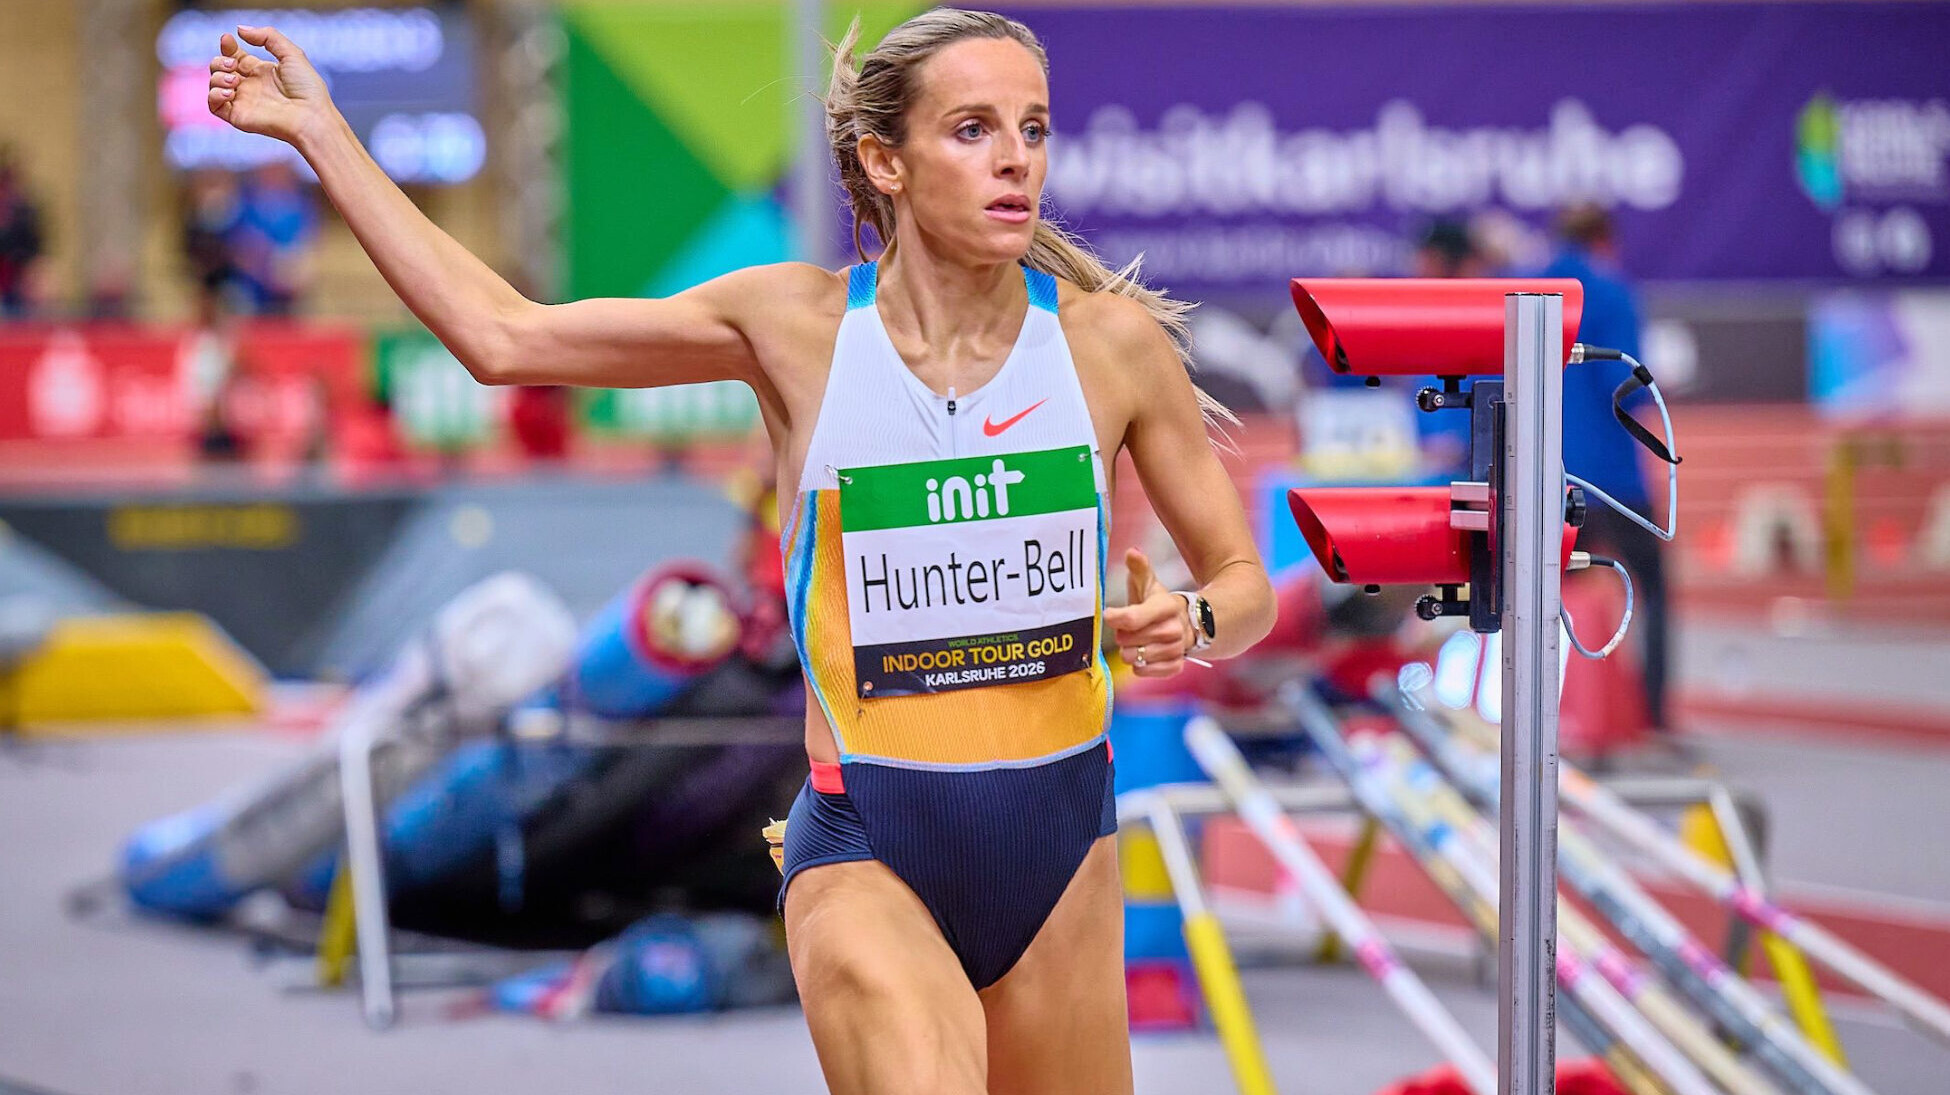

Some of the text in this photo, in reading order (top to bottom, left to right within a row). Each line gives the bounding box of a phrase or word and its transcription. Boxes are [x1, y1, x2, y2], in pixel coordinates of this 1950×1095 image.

[926, 459, 1025, 522] init
[861, 529, 1084, 613] Hunter-Bell
[883, 634, 1073, 673] INDOOR TOUR GOLD
[925, 661, 1046, 687] KARLSRUHE 2026
